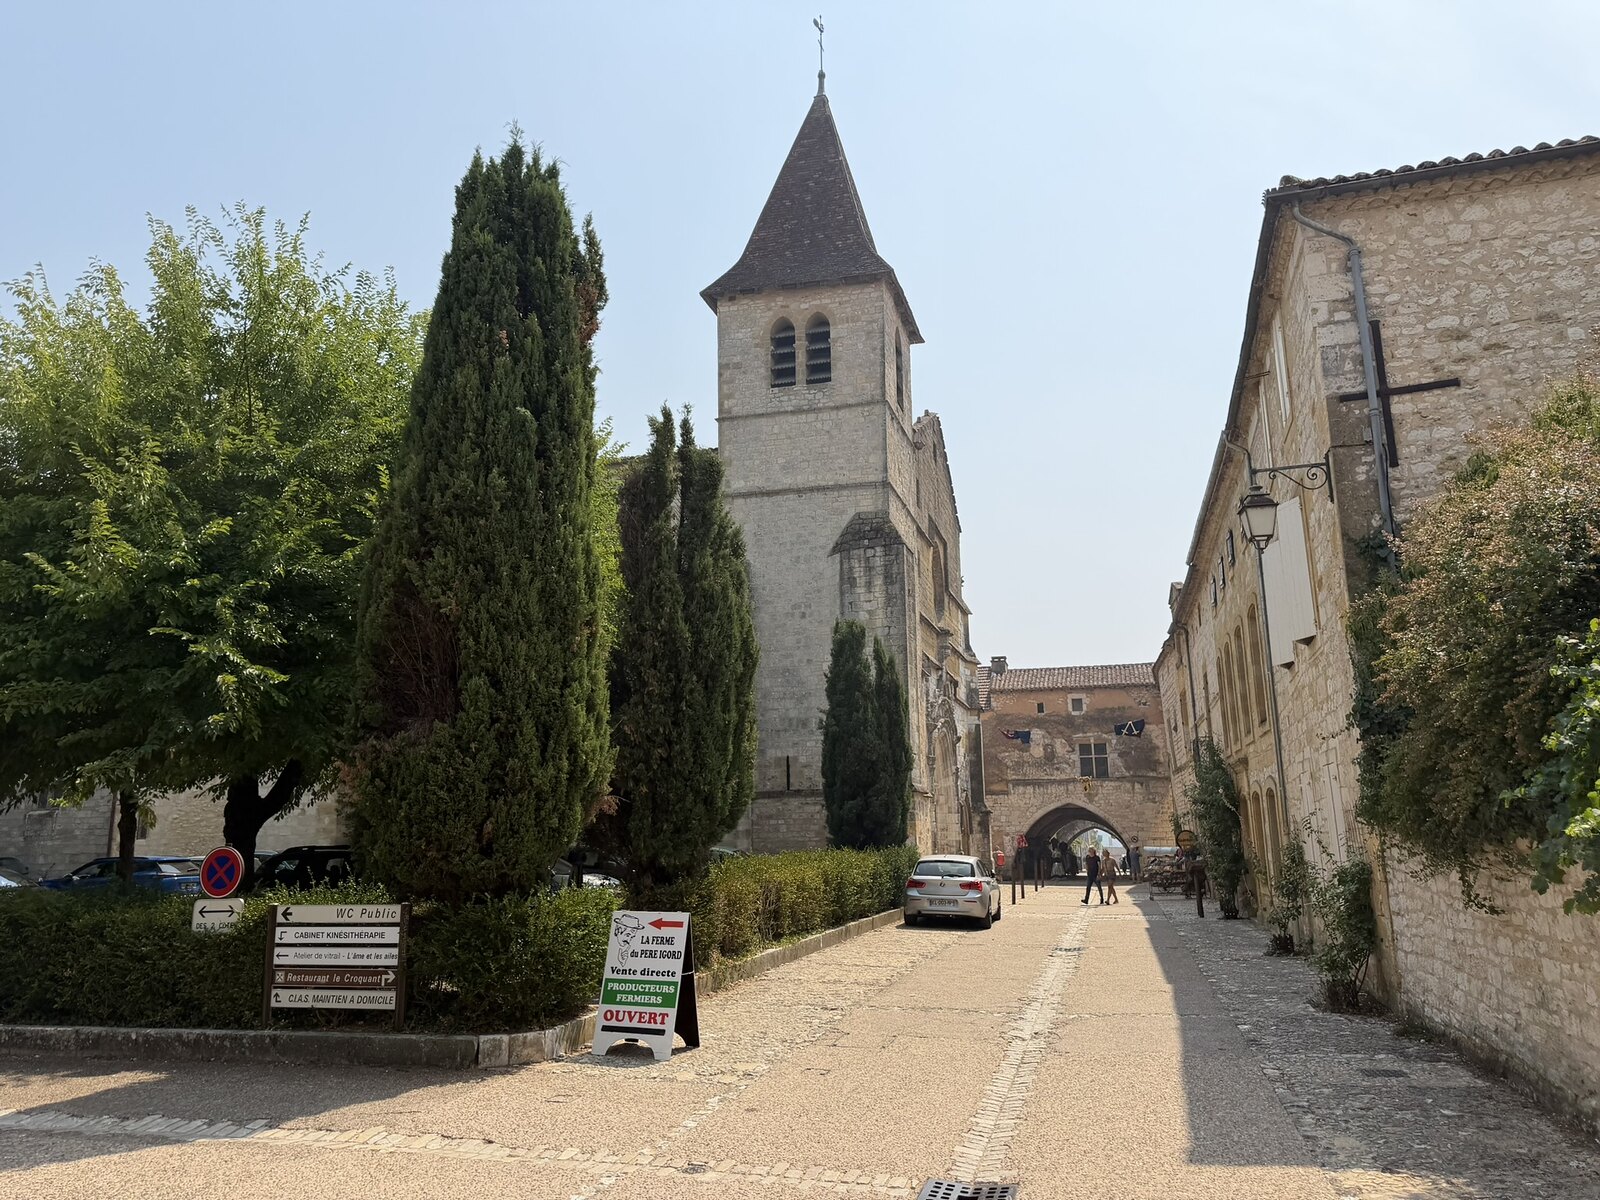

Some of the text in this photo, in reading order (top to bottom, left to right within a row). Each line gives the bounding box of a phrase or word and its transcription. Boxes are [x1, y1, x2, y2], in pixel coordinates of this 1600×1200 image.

[336, 908, 396, 918] WC Public
[326, 930, 386, 939] KINÉSITHÉRAPIE
[640, 936, 675, 945] LA FERME
[630, 949, 682, 959] du PERE IGORD
[610, 966, 676, 977] Vente directe
[287, 973, 381, 984] Restaurant le Croquant
[607, 982, 675, 993] PRODUCTEURS
[312, 995, 347, 1004] MAINTIEN
[349, 995, 355, 1004] A
[357, 995, 394, 1005] DOMICILE
[616, 994, 662, 1003] FERMIERS
[604, 1010, 669, 1025] OUVERT
